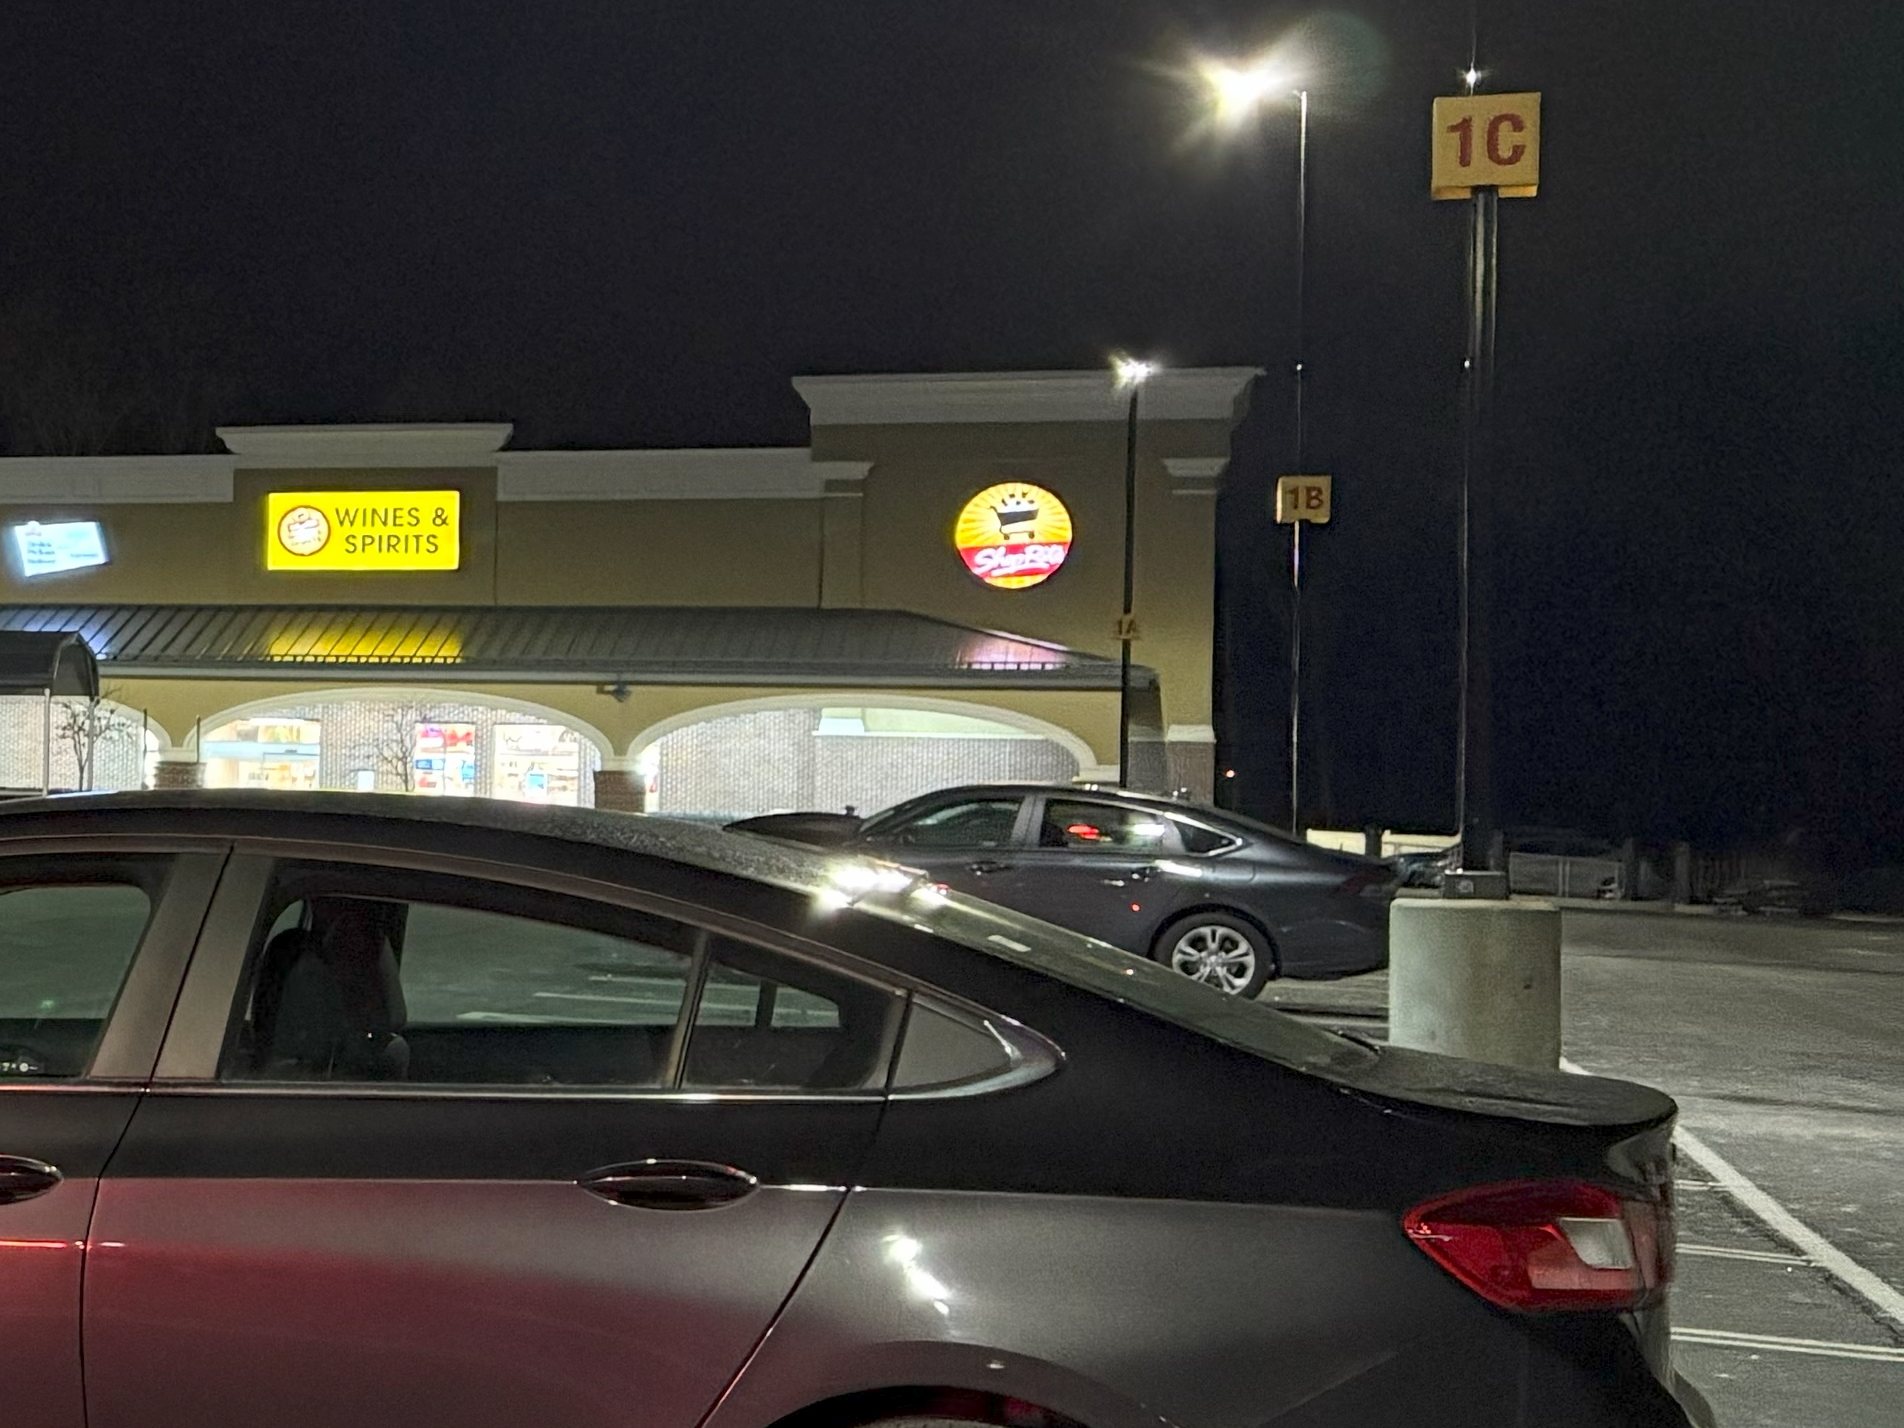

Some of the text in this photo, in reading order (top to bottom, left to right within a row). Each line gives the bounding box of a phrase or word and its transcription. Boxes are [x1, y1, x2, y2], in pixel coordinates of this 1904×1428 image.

[1446, 113, 1526, 167] 1C
[1287, 486, 1323, 509] 1B
[335, 507, 449, 528] WINES &
[345, 534, 439, 554] SPIRITS
